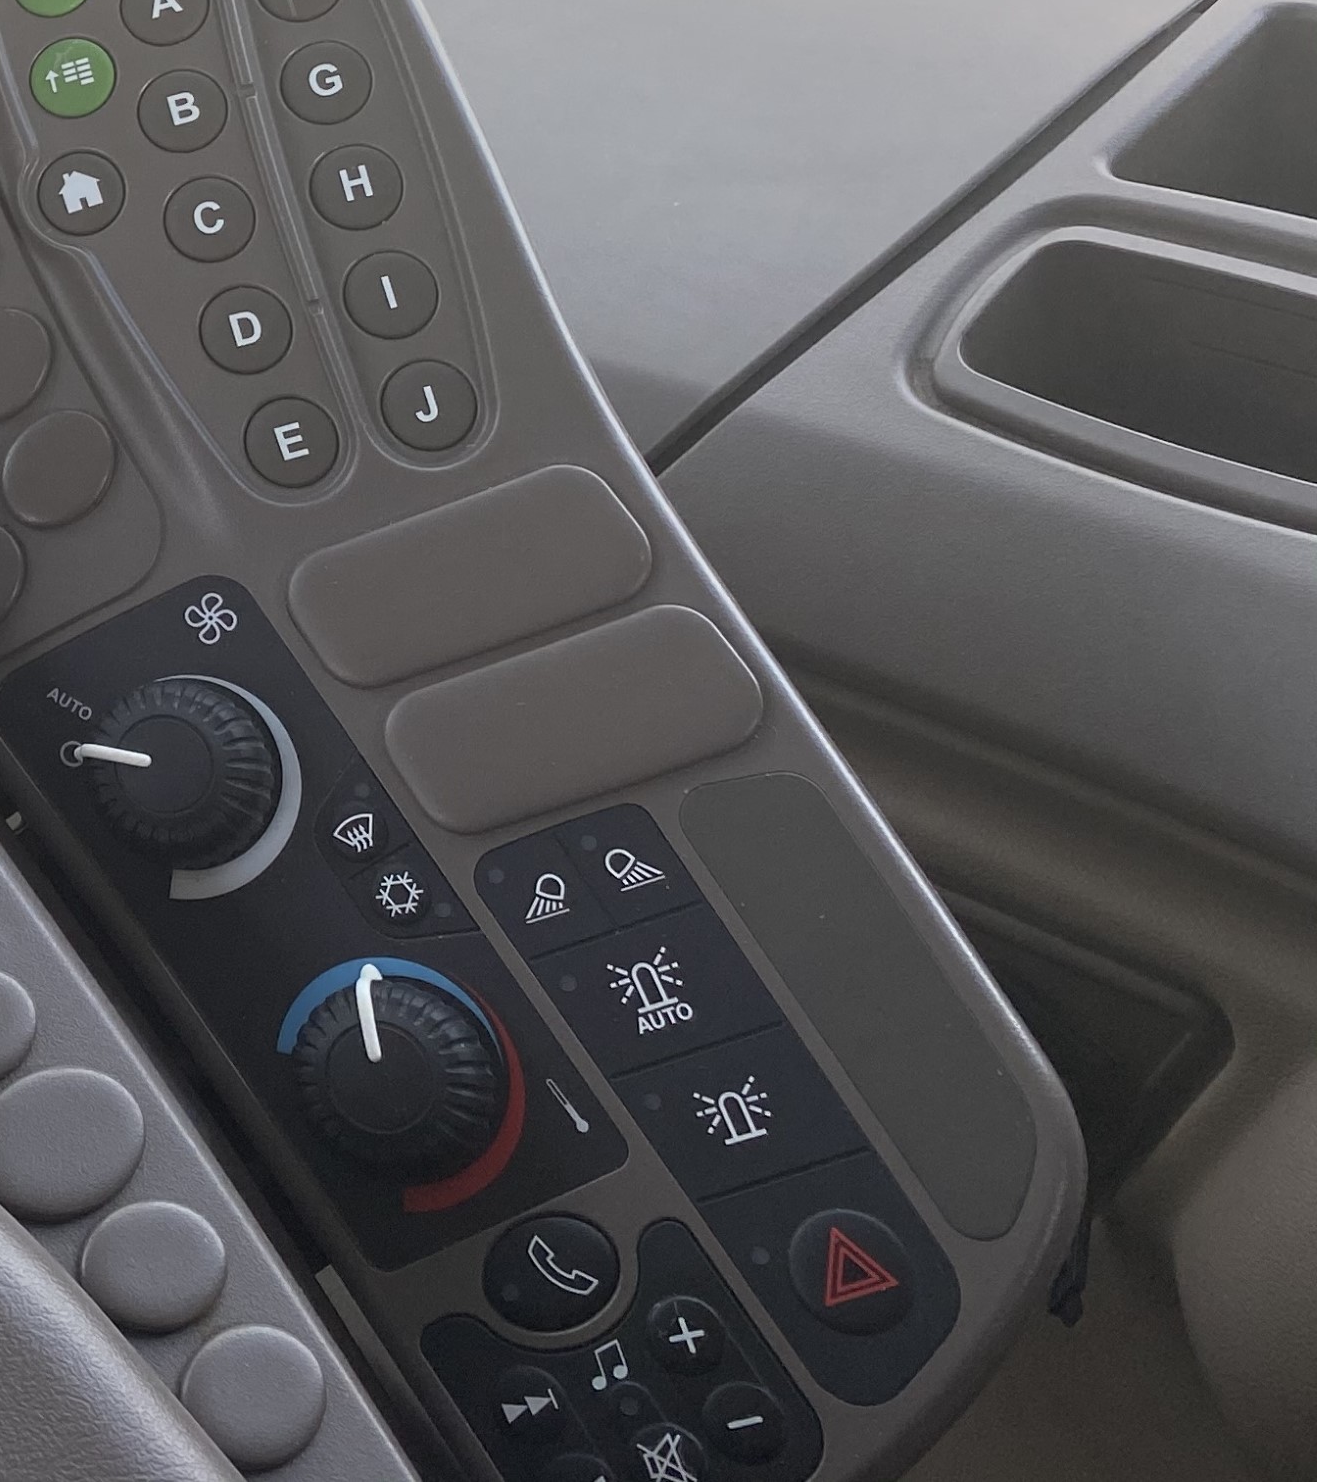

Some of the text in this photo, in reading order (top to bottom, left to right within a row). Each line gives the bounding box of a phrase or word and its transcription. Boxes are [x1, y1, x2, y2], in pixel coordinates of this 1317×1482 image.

[308, 63, 344, 97] G
[166, 91, 200, 126] B
[339, 164, 374, 202] H
[193, 200, 225, 235] C
[380, 275, 398, 309] I
[228, 311, 262, 348] D
[415, 385, 439, 423] J
[273, 421, 310, 462] E
[47, 687, 93, 720] AUTO
[637, 1002, 694, 1035] AUTO
